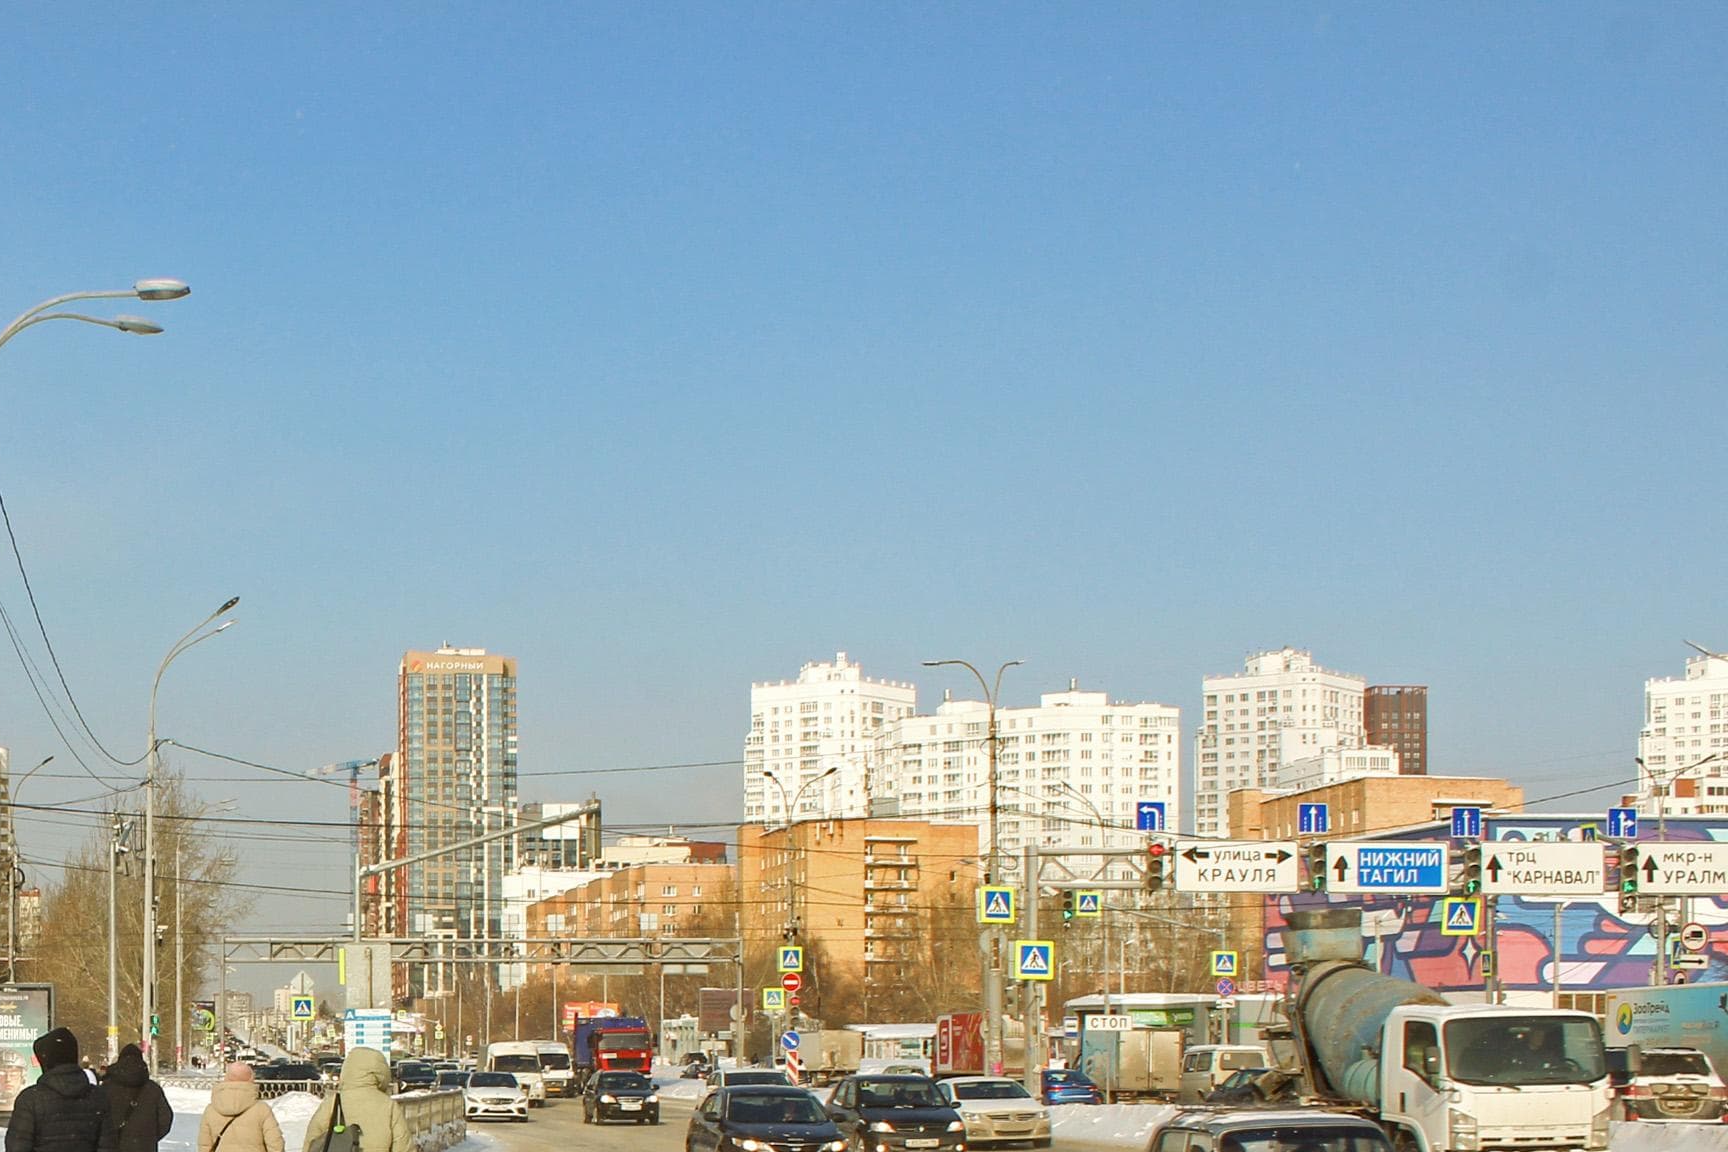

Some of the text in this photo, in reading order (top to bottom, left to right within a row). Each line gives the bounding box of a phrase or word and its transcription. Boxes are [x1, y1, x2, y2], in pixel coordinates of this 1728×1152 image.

[1213, 849, 1260, 863] улица
[1360, 849, 1440, 867] НИЖНИЙ
[1663, 852, 1713, 866] мкр-н
[1197, 869, 1276, 882] КРАУЛЯ
[1361, 868, 1418, 883] ТАГИЛ
[1090, 1017, 1128, 1029] СТОП
